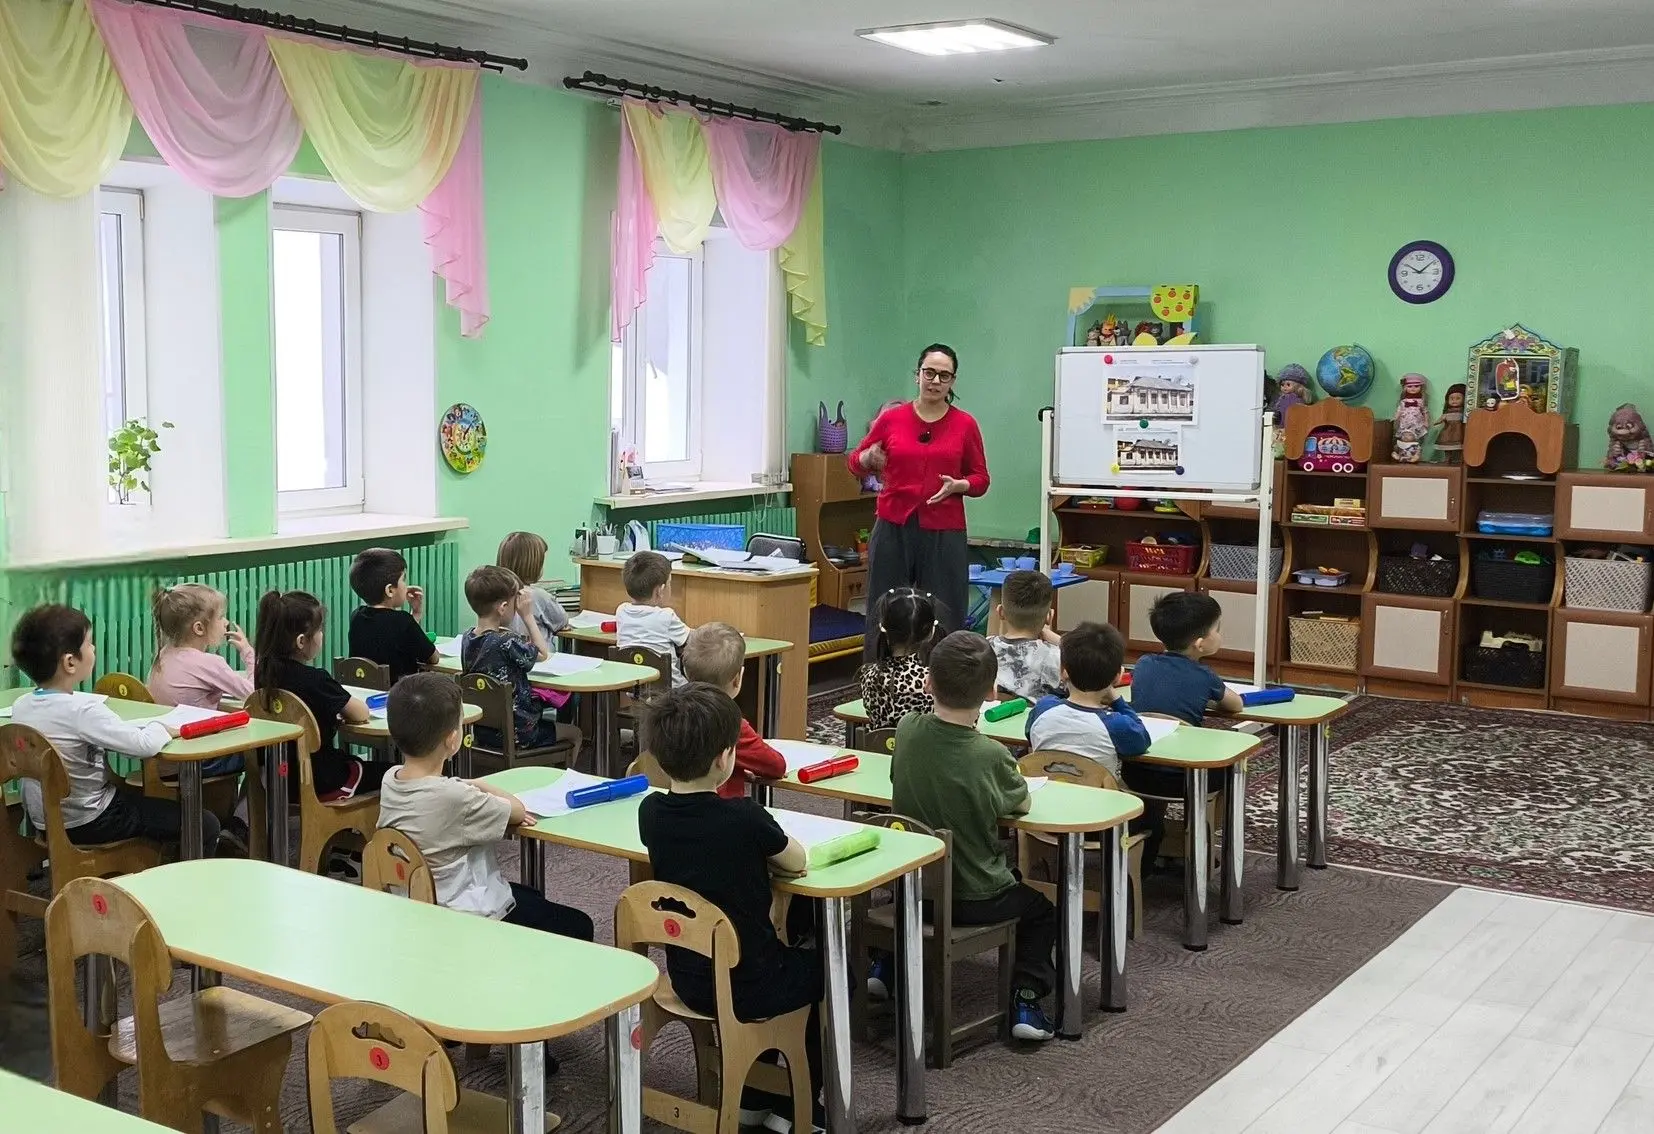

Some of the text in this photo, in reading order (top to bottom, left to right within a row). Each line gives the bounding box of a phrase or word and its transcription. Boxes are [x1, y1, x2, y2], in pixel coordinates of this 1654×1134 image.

[1415, 254, 1425, 262] 12
[1432, 268, 1440, 276] 3
[96, 901, 102, 911] 3
[376, 1054, 383, 1067] 3
[674, 1107, 679, 1118] 3
